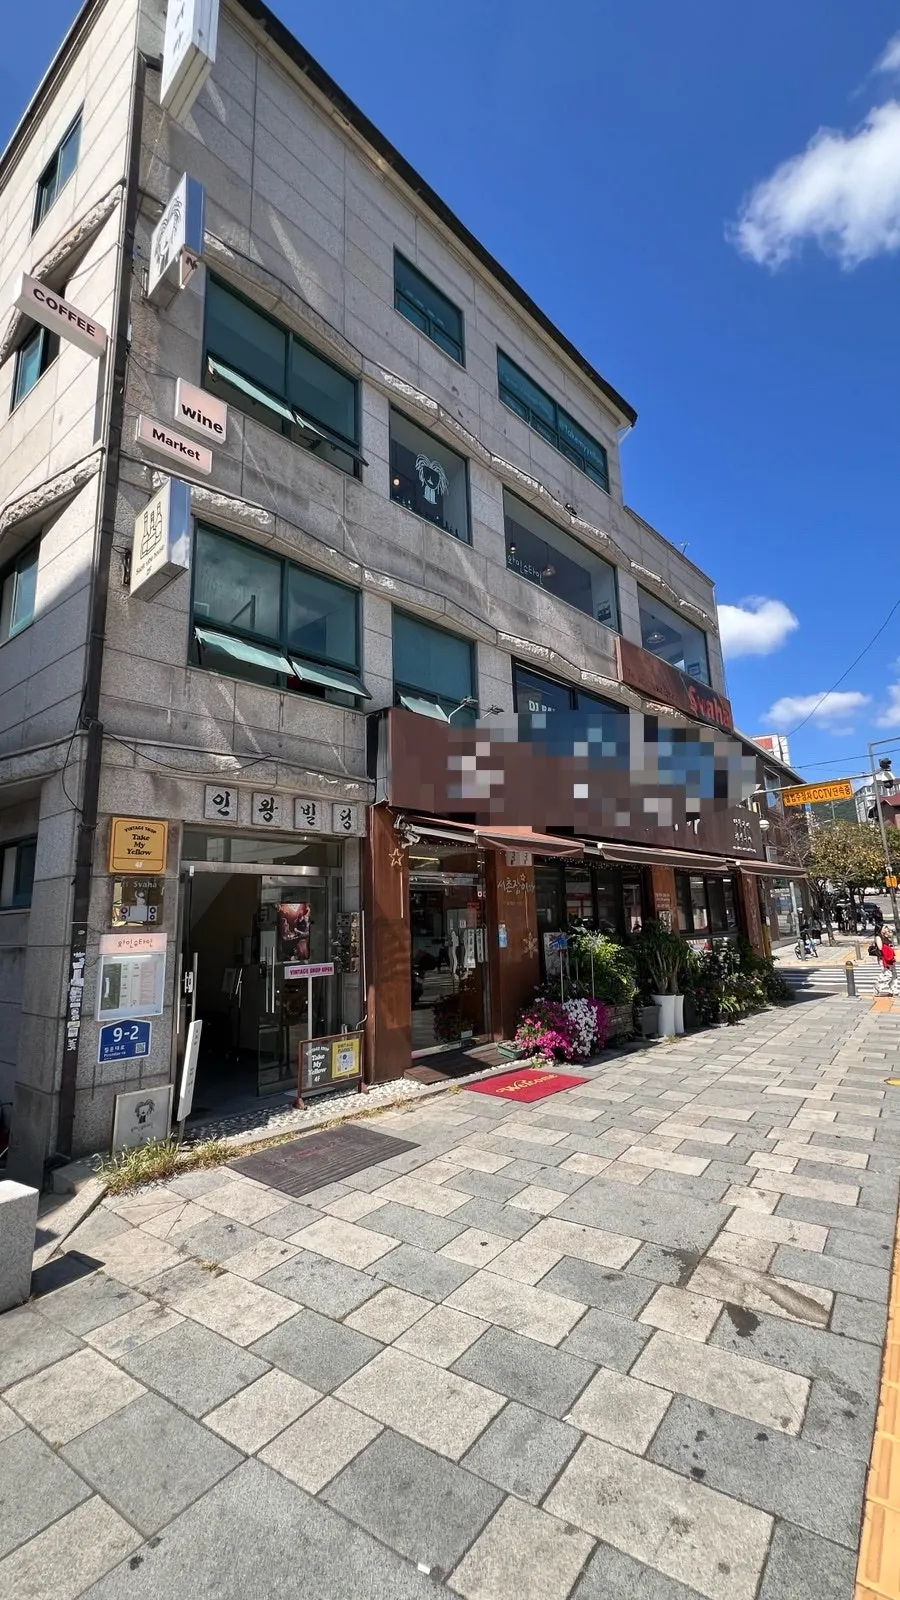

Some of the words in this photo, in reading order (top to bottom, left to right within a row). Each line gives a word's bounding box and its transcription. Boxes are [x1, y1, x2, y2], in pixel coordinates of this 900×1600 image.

[33, 288, 96, 337] COFFEE
[181, 404, 224, 434] wine
[152, 427, 201, 461] Market
[688, 685, 733, 729] Svaha
[144, 826, 157, 834] SHOP
[133, 841, 146, 849] My
[126, 848, 152, 856] Yellow
[290, 967, 309, 976] VINTAGE
[309, 966, 321, 974] SHOP
[321, 965, 333, 973] OPEN
[113, 1025, 139, 1043] 9-2
[313, 1061, 323, 1069] My
[308, 1067, 327, 1076] Yellow
